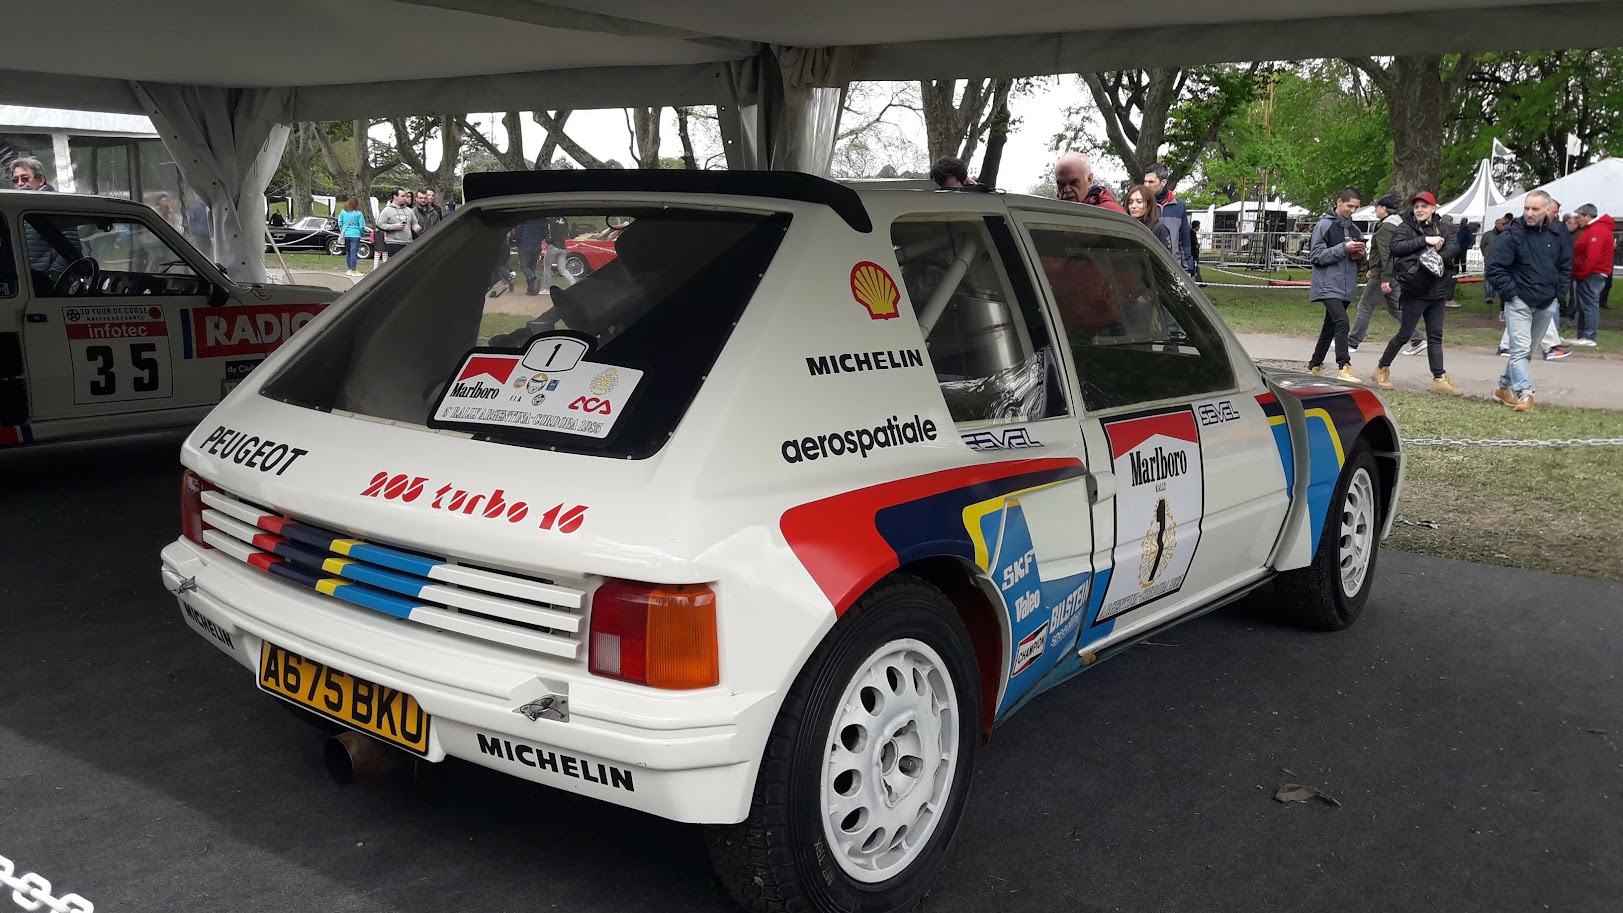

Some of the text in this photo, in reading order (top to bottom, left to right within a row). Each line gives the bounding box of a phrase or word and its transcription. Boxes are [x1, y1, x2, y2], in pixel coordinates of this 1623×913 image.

[88, 323, 148, 339] infotec
[92, 307, 112, 315] TOUR
[113, 307, 123, 315] DE
[124, 306, 148, 315] CORSE
[86, 343, 159, 396] 35
[227, 364, 237, 374] de
[545, 343, 563, 368] 1
[805, 349, 924, 376] MICHELIN
[449, 381, 500, 400] Marlboro
[1198, 400, 1240, 426] SEVEL
[199, 425, 309, 476] PEUGEOT
[781, 414, 938, 464] aerospatiale
[1129, 446, 1187, 487] Marlboro
[359, 471, 590, 534] 205 turbo 16
[1147, 498, 1166, 582] 1
[1001, 548, 1035, 592] SKF
[183, 601, 236, 651] MICHELIN
[1014, 588, 1041, 623] Valeo
[1049, 575, 1091, 635] BILSTEIN
[1017, 634, 1047, 665] CHAMPION
[263, 643, 344, 713] A675
[476, 732, 635, 792] MICHELIN
